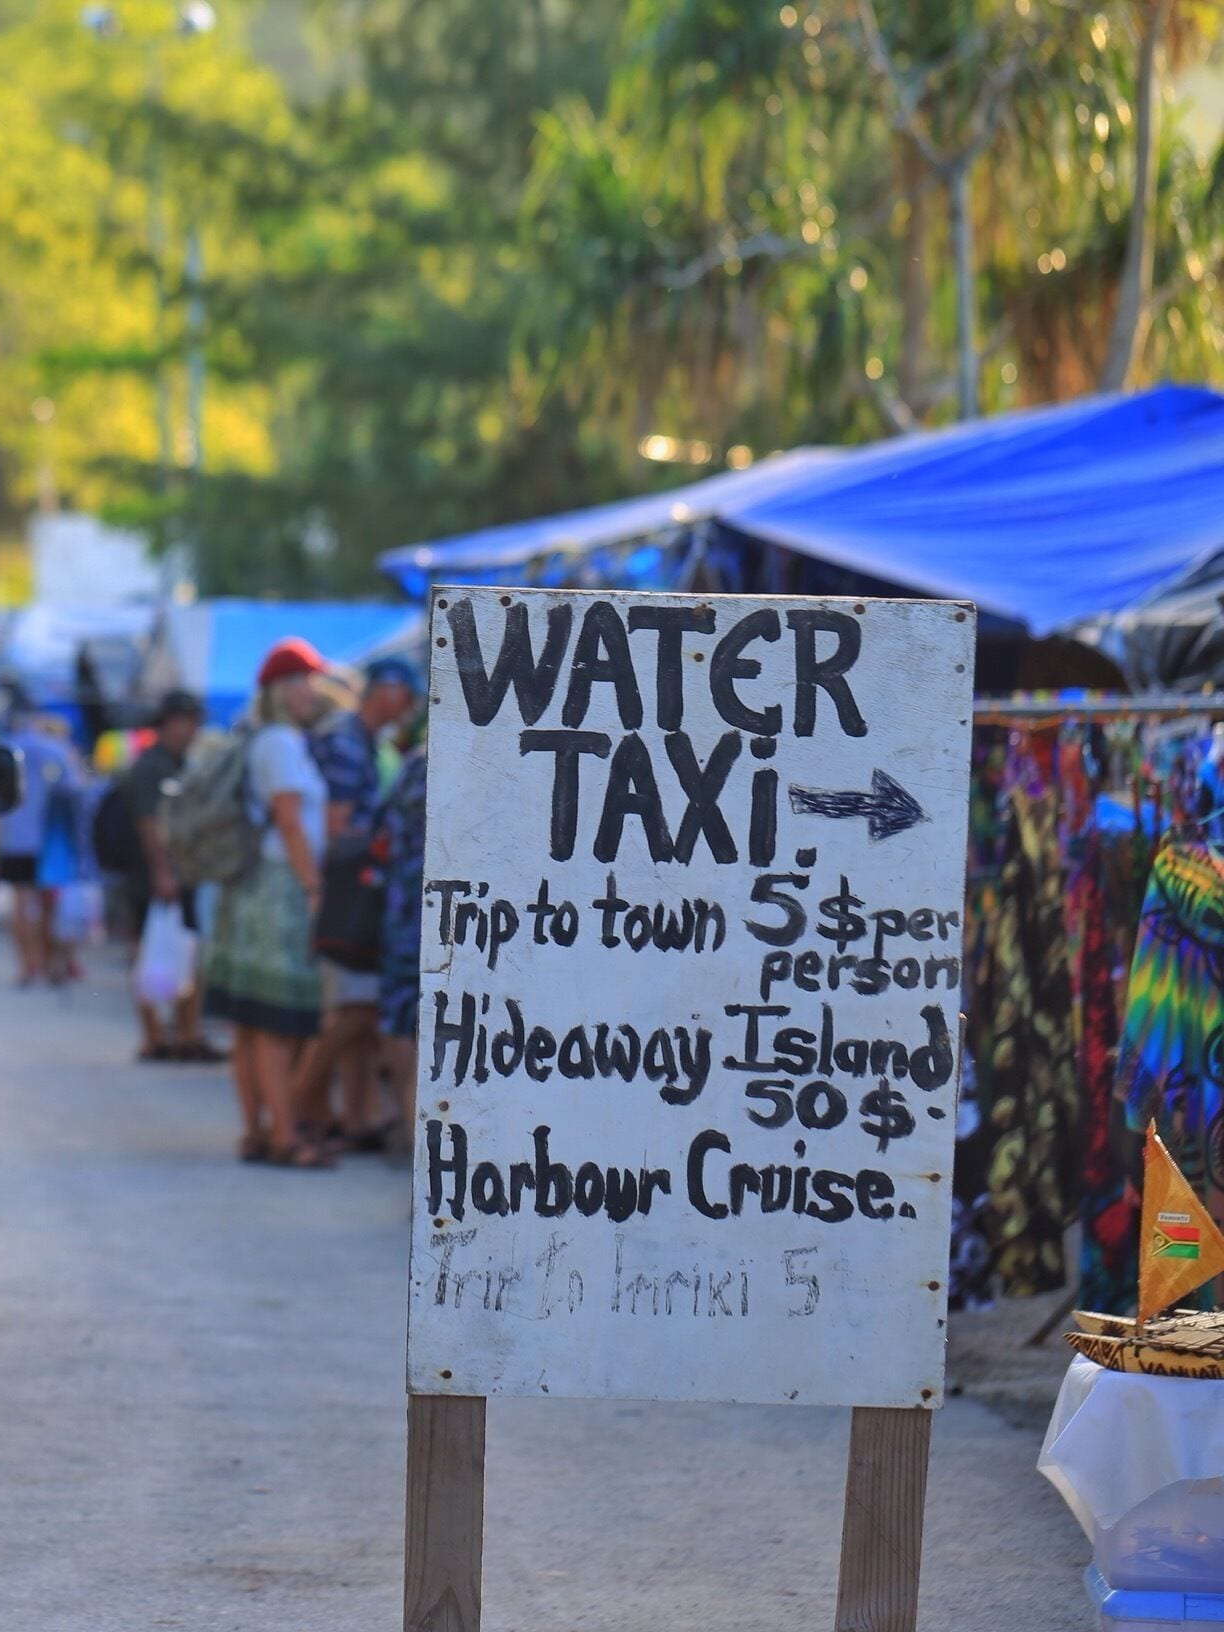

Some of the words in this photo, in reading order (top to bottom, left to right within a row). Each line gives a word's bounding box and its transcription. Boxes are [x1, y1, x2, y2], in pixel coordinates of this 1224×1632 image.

[447, 597, 868, 738] WATER
[425, 880, 519, 970] Trip
[526, 877, 579, 947] to
[592, 871, 726, 953] town
[868, 906, 960, 962] per
[760, 948, 960, 1002] person
[429, 991, 712, 1106] Hideaway
[722, 1002, 954, 1091] Island
[424, 1119, 672, 1223] Harbour
[687, 1128, 917, 1223] Cruise.
[784, 1246, 821, 1316] 5
